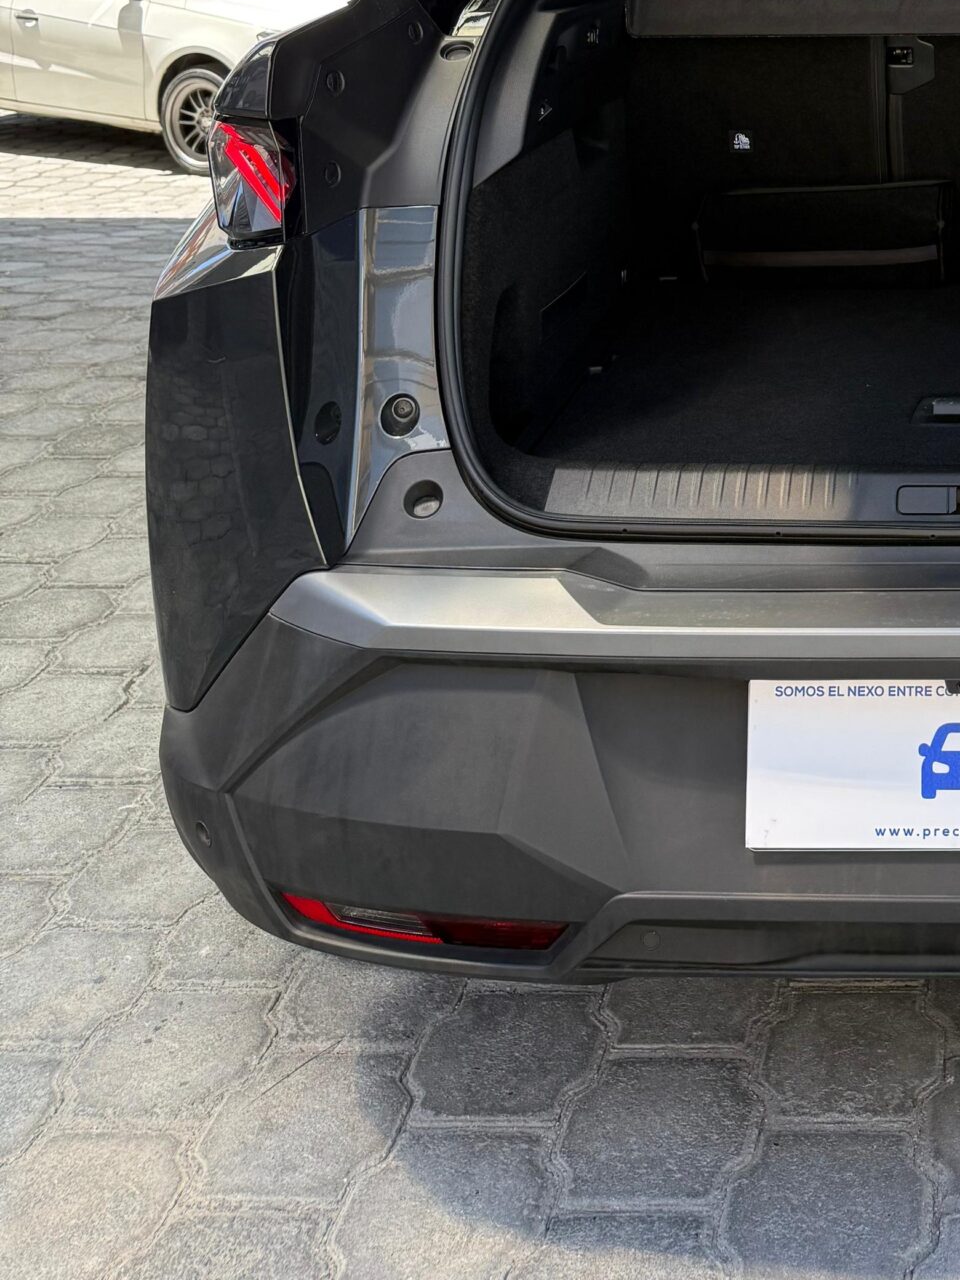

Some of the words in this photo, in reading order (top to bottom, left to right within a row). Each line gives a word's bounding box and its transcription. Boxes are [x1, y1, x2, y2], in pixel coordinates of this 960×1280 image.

[775, 686, 825, 697] SOMOS
[828, 686, 844, 696] EL
[847, 686, 884, 697] NEXO
[888, 686, 932, 697] ENTRE
